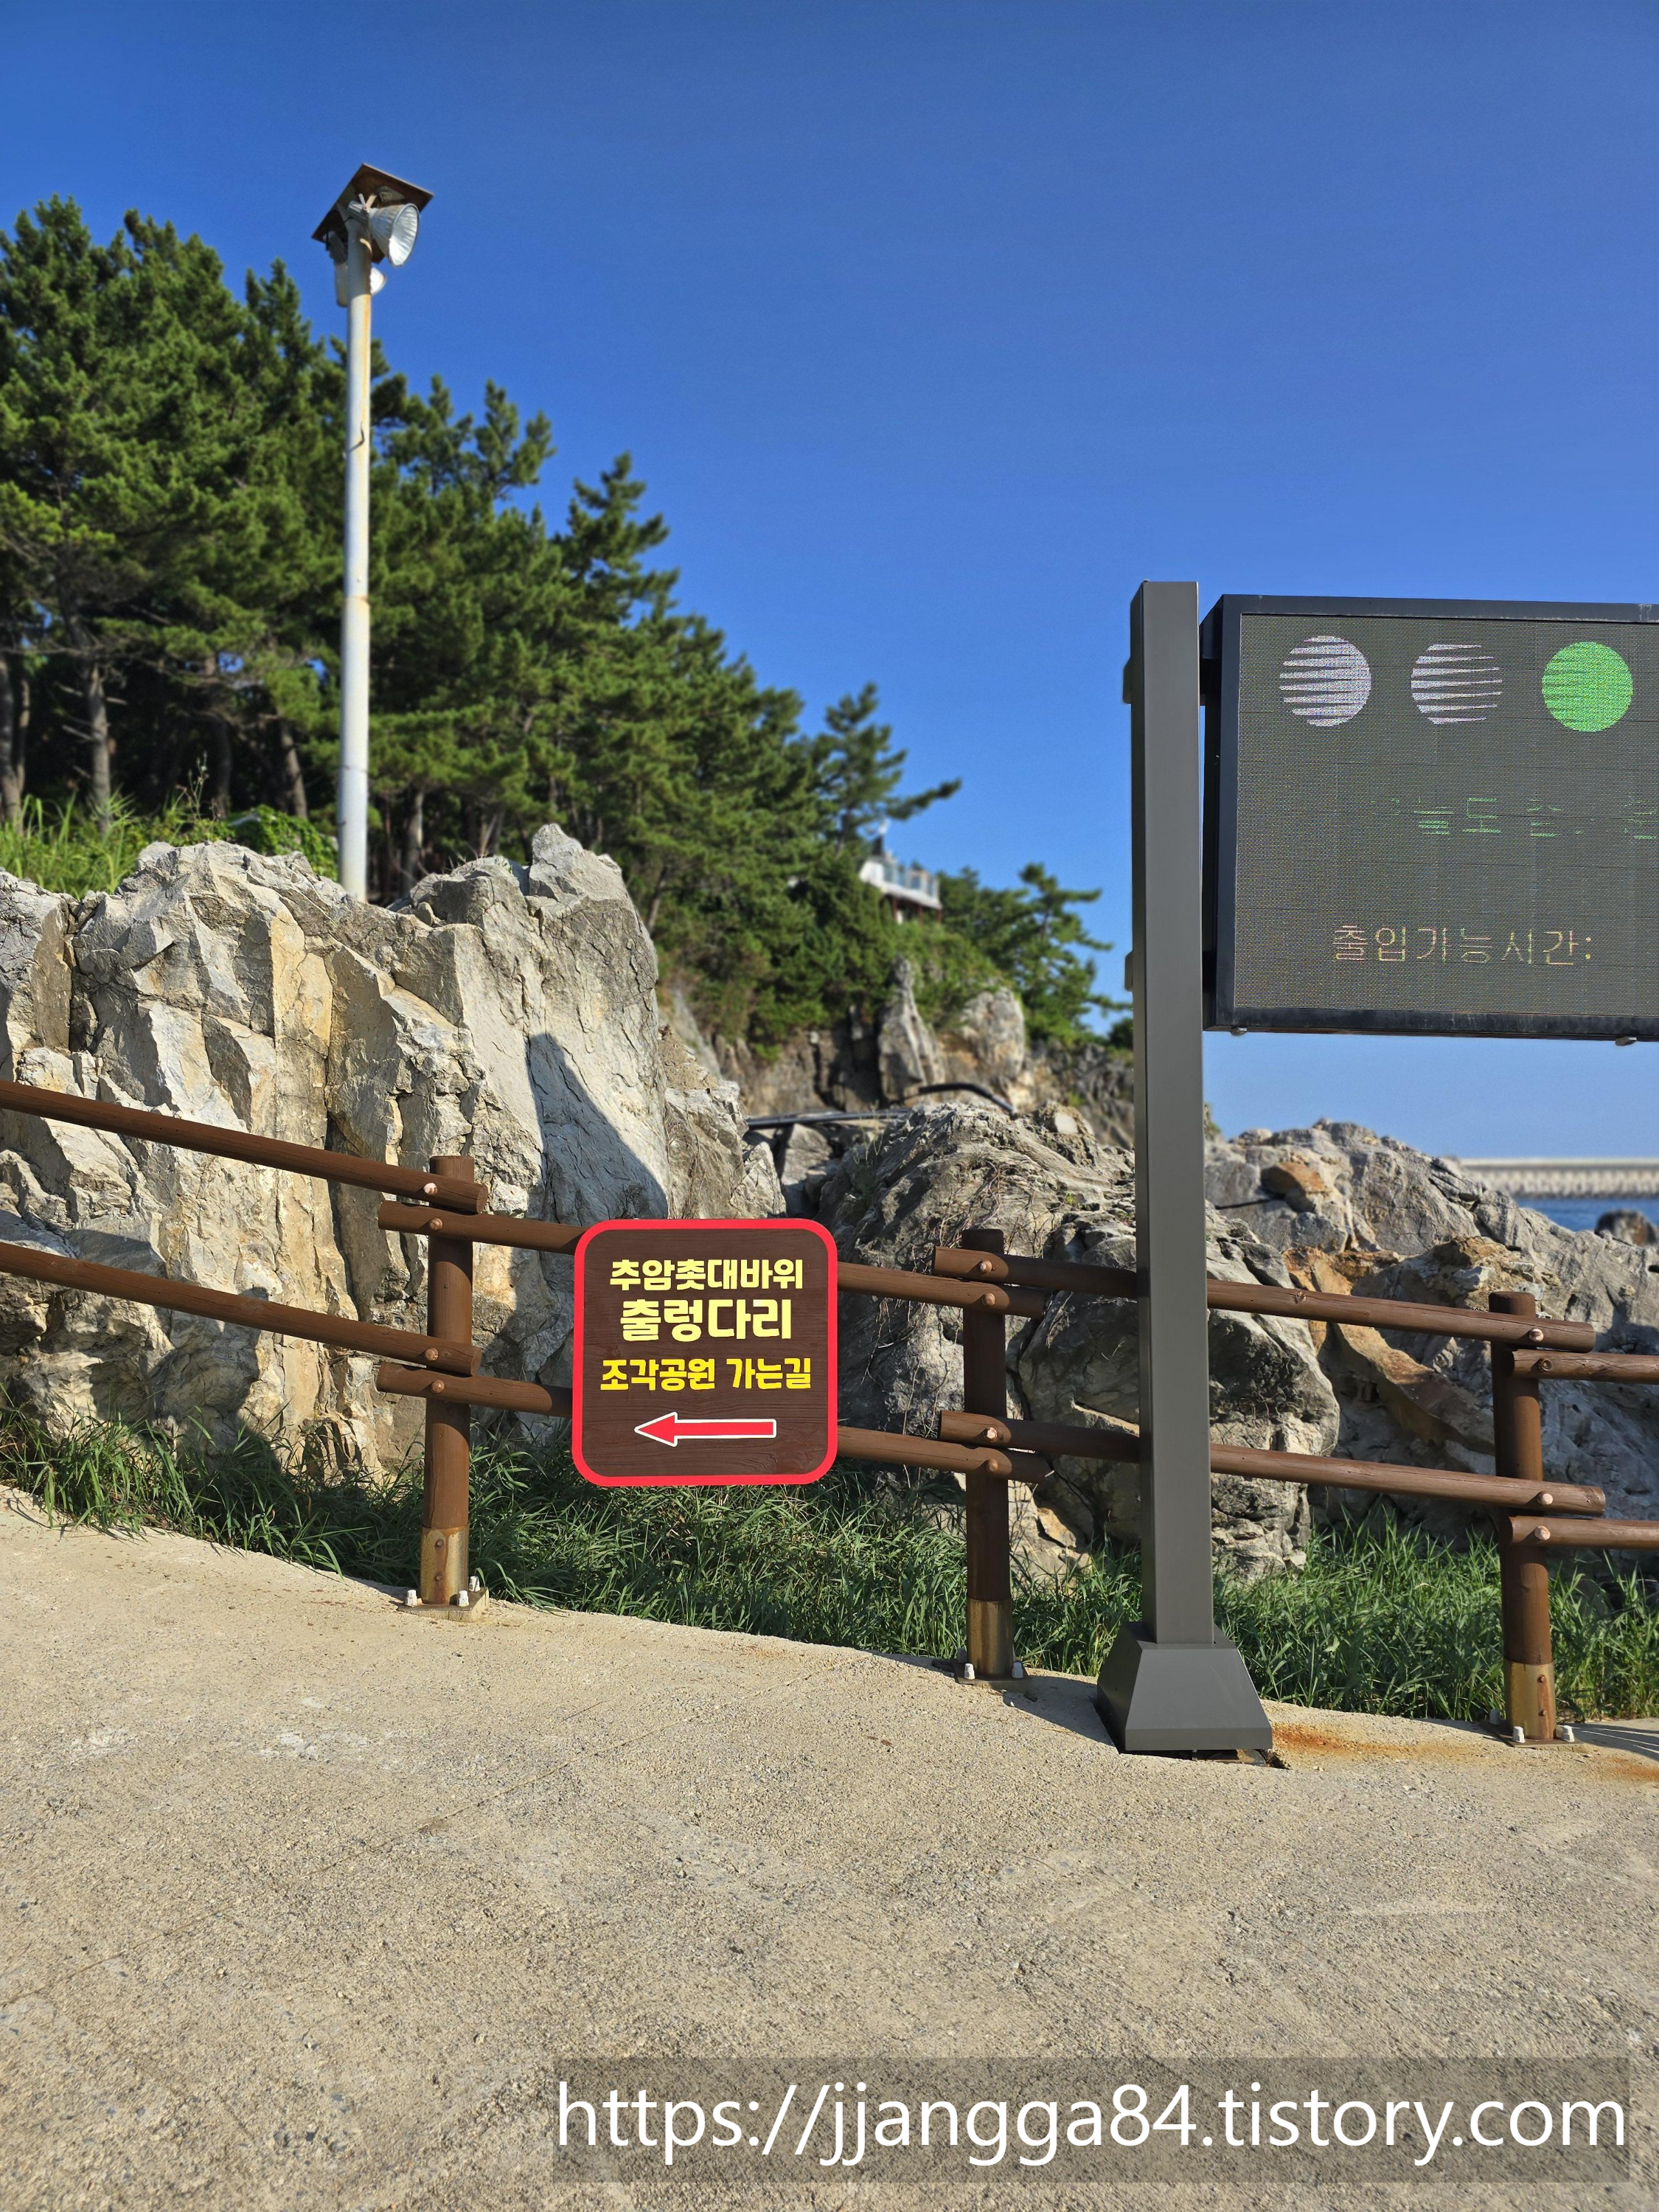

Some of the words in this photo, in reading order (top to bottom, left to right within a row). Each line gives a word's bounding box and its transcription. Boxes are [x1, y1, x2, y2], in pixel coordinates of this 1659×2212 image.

[610, 1259, 803, 1290] 추암촛대바위
[620, 1298, 792, 1342] 출렁다리
[600, 1358, 716, 1391] 조각공원
[726, 1357, 812, 1389] 가는길
